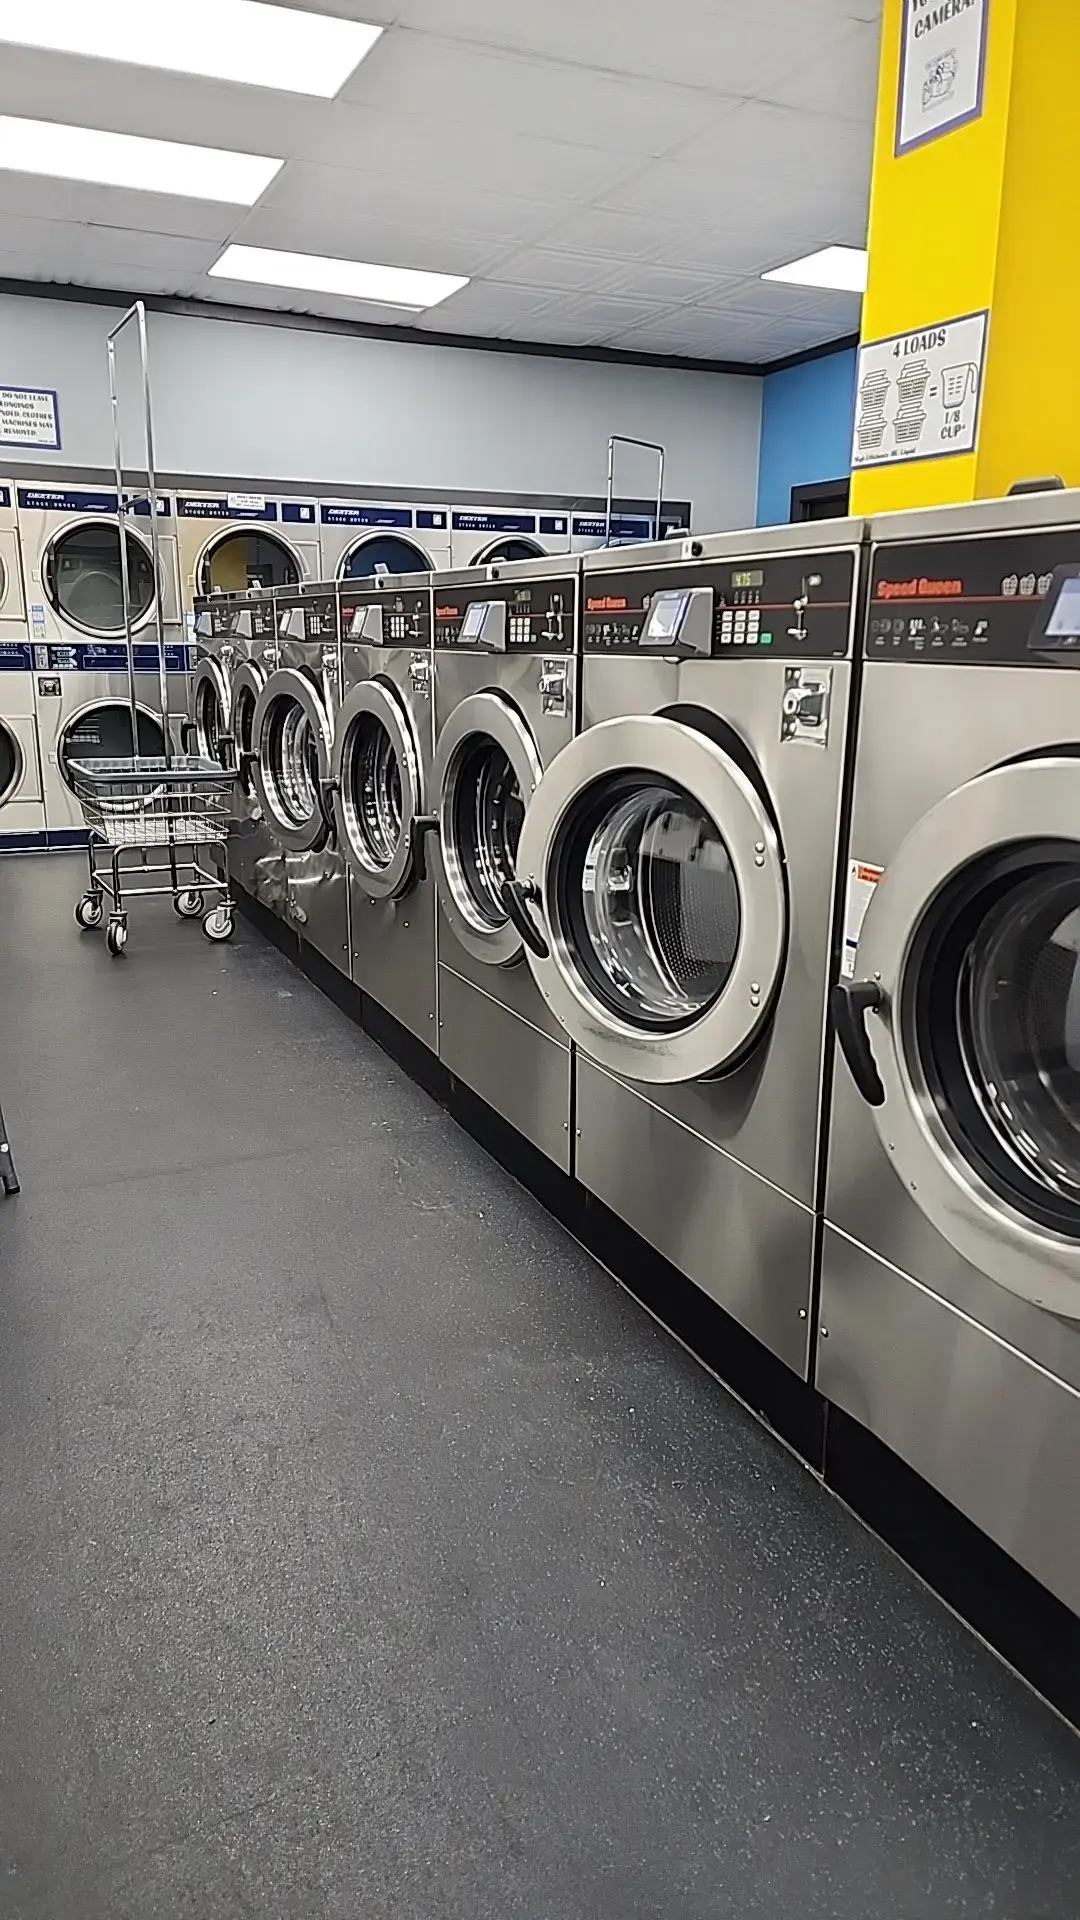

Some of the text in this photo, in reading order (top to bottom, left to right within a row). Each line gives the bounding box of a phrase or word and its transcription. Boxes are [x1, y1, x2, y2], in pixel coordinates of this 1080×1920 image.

[893, 328, 947, 358] 4 LOADS
[22, 412, 53, 420] CLOTHES
[945, 409, 961, 424] 1/8
[2, 419, 38, 427] MACHINES
[26, 492, 65, 500] DEXTER
[877, 578, 962, 599] Speed Queen
